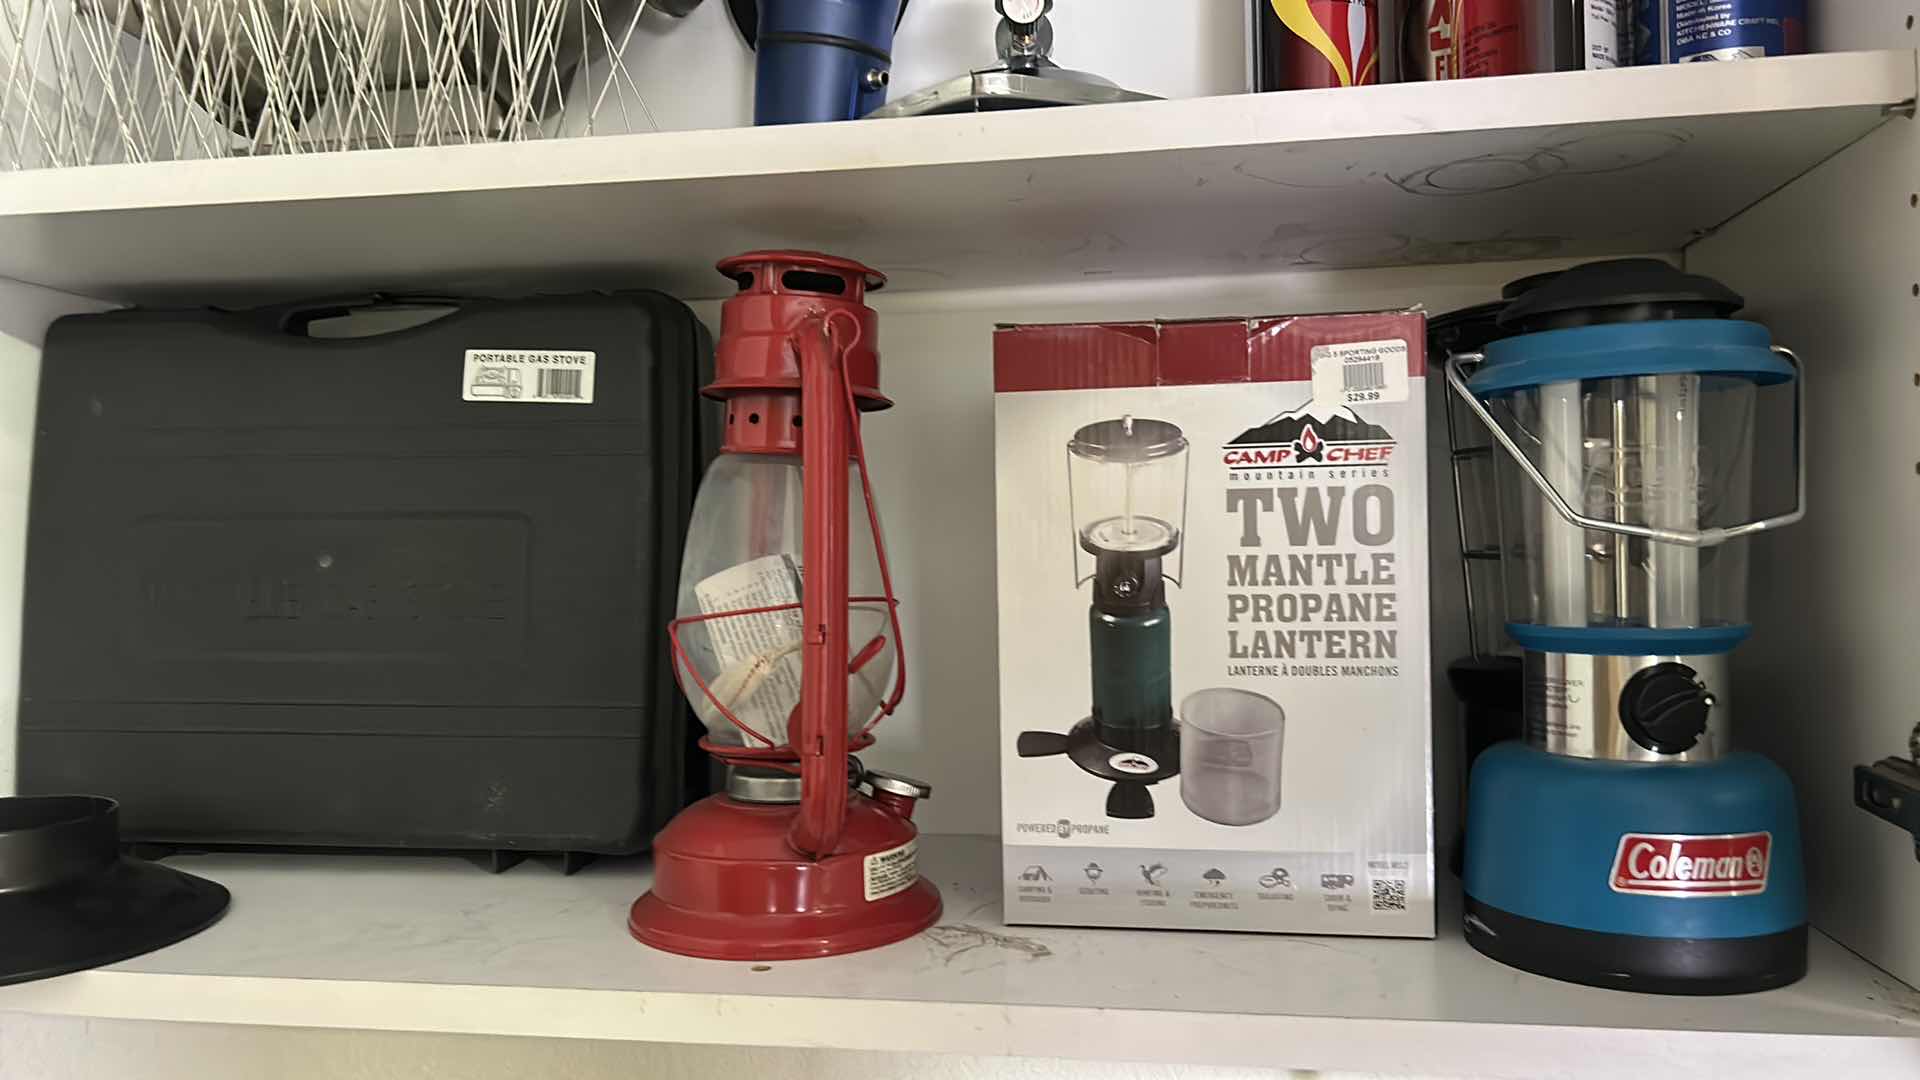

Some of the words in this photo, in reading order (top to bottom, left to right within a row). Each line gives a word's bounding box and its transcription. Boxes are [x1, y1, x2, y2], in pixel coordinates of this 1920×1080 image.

[1708, 3, 1732, 11] Korea
[1718, 28, 1732, 36] CO
[1340, 347, 1377, 356] SPORTING
[1378, 345, 1406, 353] GOODS
[473, 353, 525, 363] PORTABLE
[528, 354, 549, 363] GAS
[552, 355, 586, 364] STOVE
[1347, 391, 1380, 402] $29.99
[1223, 449, 1291, 464] CAMP
[1326, 446, 1393, 462] CHEF
[1229, 470, 1315, 481] mountain
[1328, 467, 1391, 479] series
[1226, 484, 1395, 547] TWO
[1227, 553, 1396, 586] MANTLE
[1227, 592, 1397, 623] PROPANE
[1227, 630, 1398, 659] LANTERN
[1227, 665, 1278, 677] LANTERNE
[1281, 663, 1289, 677] À
[1291, 665, 1338, 677] DOUBLES
[1341, 665, 1400, 677] MANCHONS
[1016, 823, 1056, 833] POWERED
[1071, 824, 1110, 835] PROPANE
[1628, 842, 1743, 881] Coleman
